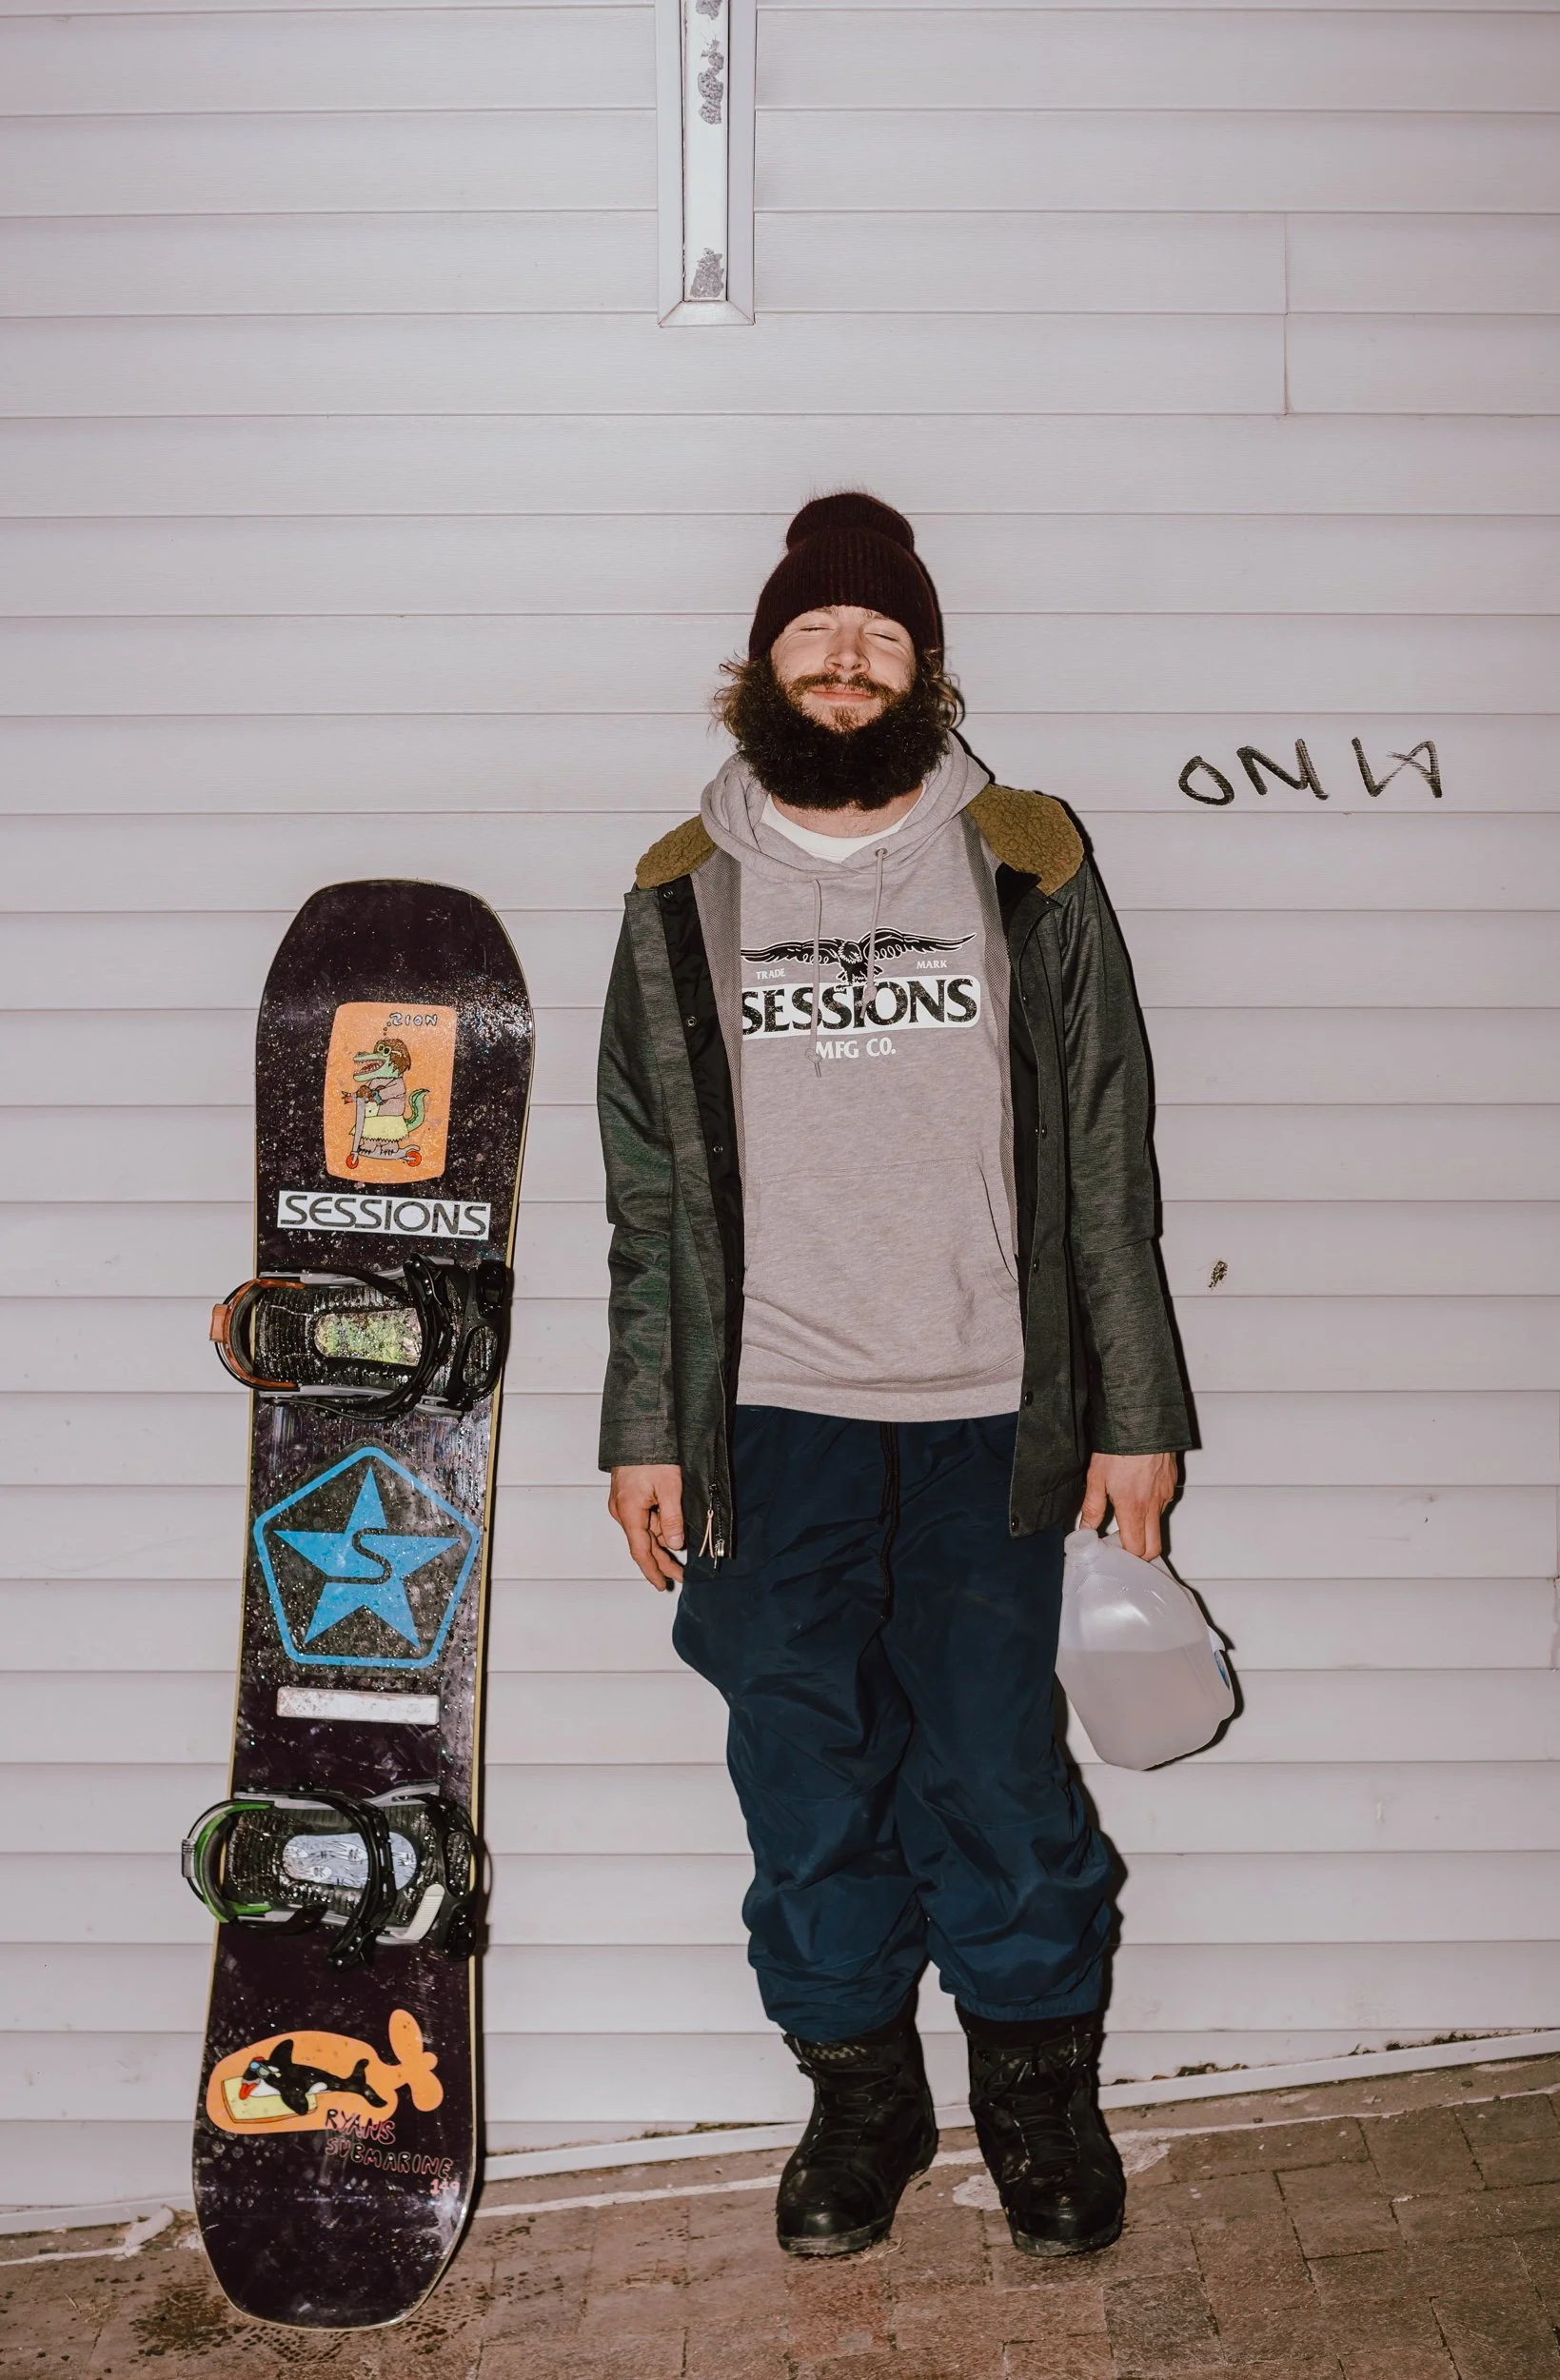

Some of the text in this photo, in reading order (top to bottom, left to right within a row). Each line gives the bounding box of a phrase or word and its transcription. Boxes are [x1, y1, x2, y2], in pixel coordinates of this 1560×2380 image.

[756, 968, 786, 980] TRADE
[917, 960, 947, 969] MARK
[389, 1012, 438, 1026] ZION
[742, 977, 977, 1035] SESSIONS
[816, 1036, 897, 1060] MFG CO.
[280, 1194, 487, 1237] SESSIONS
[325, 2109, 396, 2145] RYANS
[325, 2137, 453, 2179] SUBMARINE
